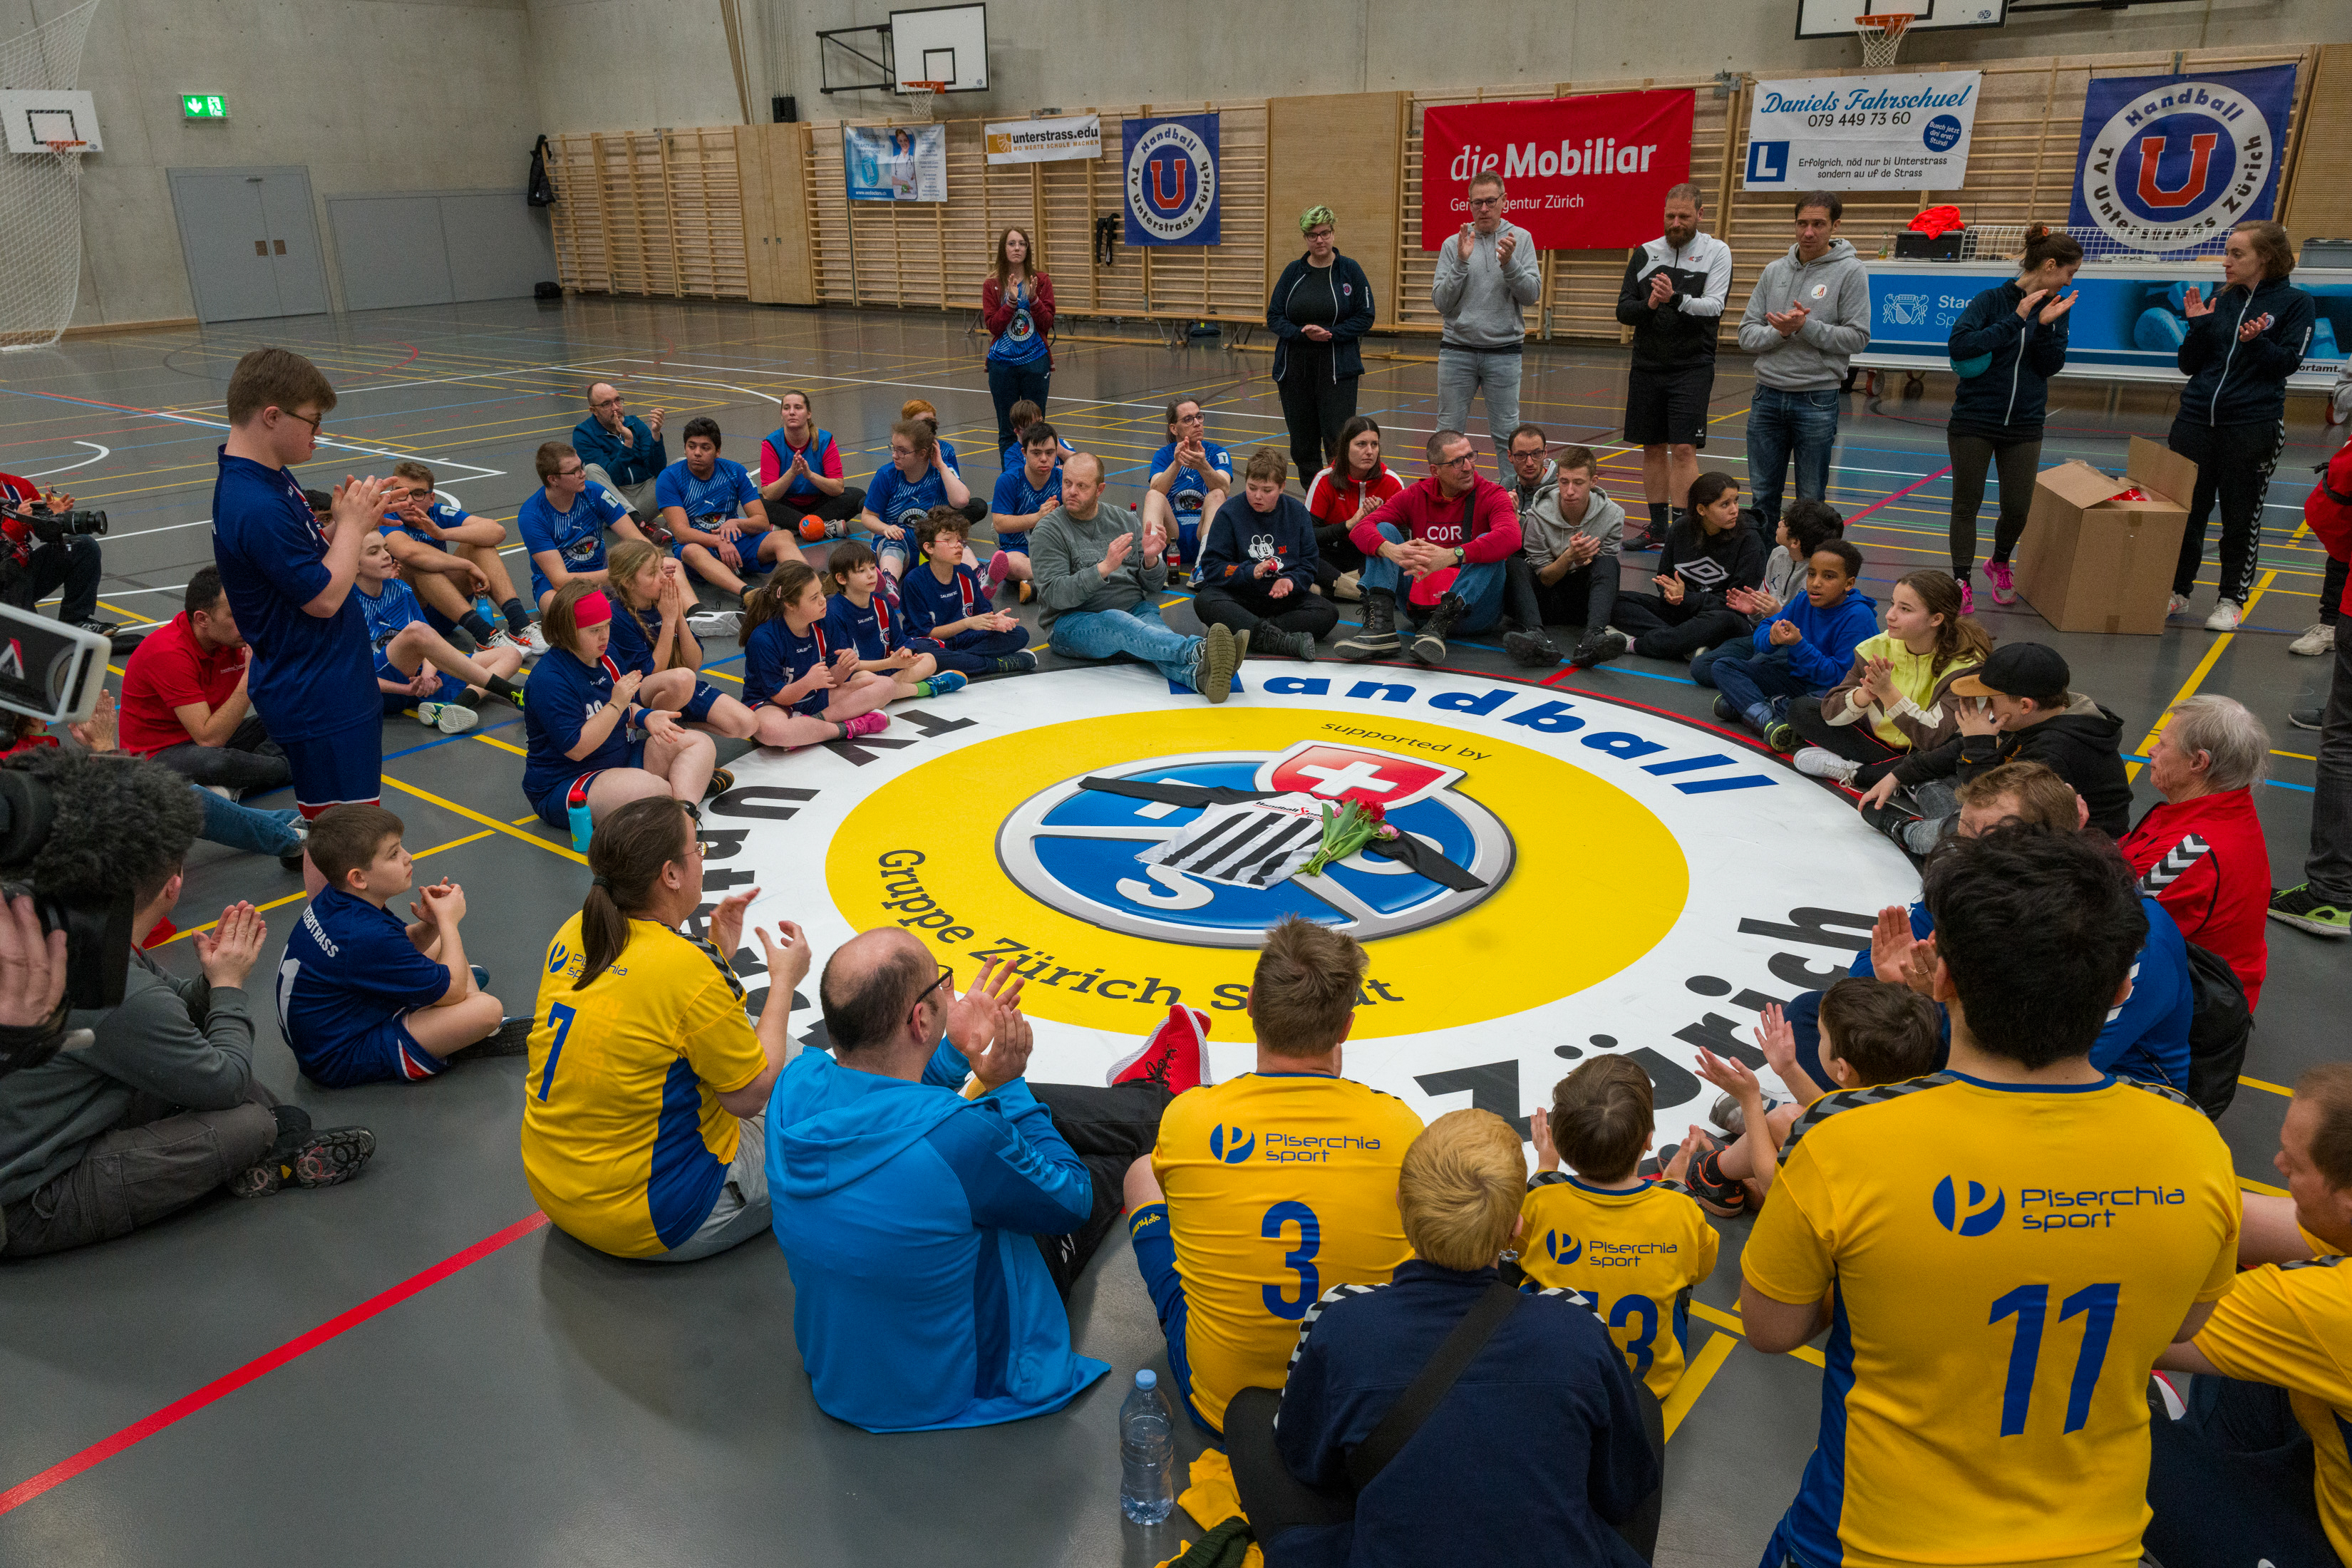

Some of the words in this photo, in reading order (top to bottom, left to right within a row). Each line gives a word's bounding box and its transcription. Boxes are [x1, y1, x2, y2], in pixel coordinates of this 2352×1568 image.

[1760, 91, 1840, 113] Daniels
[1845, 85, 1973, 110] Fahrschuel
[2125, 88, 2244, 128] Handball
[1808, 114, 1834, 128] 079
[1838, 113, 1865, 126] 449
[1870, 112, 1887, 125] 73
[1892, 111, 1911, 125] 60
[1013, 126, 1098, 144] unterstrass.edu
[1140, 127, 1197, 154] Handball
[1450, 144, 1499, 181] die
[1503, 137, 1657, 179] Mobiliar
[1755, 145, 1778, 177] L
[1798, 158, 1843, 167] Erfolgrich,
[1846, 158, 1862, 166] nöd
[1883, 157, 1892, 165] bi
[1894, 157, 1947, 166] Unterstrass
[1131, 167, 1140, 187] TV
[1817, 168, 1851, 178] sondern
[1867, 169, 1879, 178] uf
[1880, 168, 1892, 177] de
[1894, 168, 1923, 177] Strass
[2093, 147, 2115, 175] TV
[2222, 135, 2263, 215] Zürich
[1194, 160, 1210, 215] Zürich
[1133, 192, 1194, 232] Unterstrass
[1544, 193, 1584, 208] Zürich
[1, 508, 16, 520] RONIN
[1321, 722, 1453, 753] supported
[1457, 746, 1493, 762] by
[1255, 801, 1299, 813] Handball
[878, 849, 974, 944] Gruppe
[968, 937, 1182, 1006] Zürich
[537, 1001, 577, 1103] 7
[1265, 1133, 1381, 1150] Piserchia
[1265, 1149, 1330, 1163] sport
[2021, 1185, 2185, 1209] Piserchia
[2023, 1209, 2116, 1233] sport
[1589, 1240, 1678, 1254] Piserchia
[1261, 1200, 1321, 1321] 3
[1590, 1255, 1641, 1268] sport
[1987, 1282, 2122, 1438] 11
